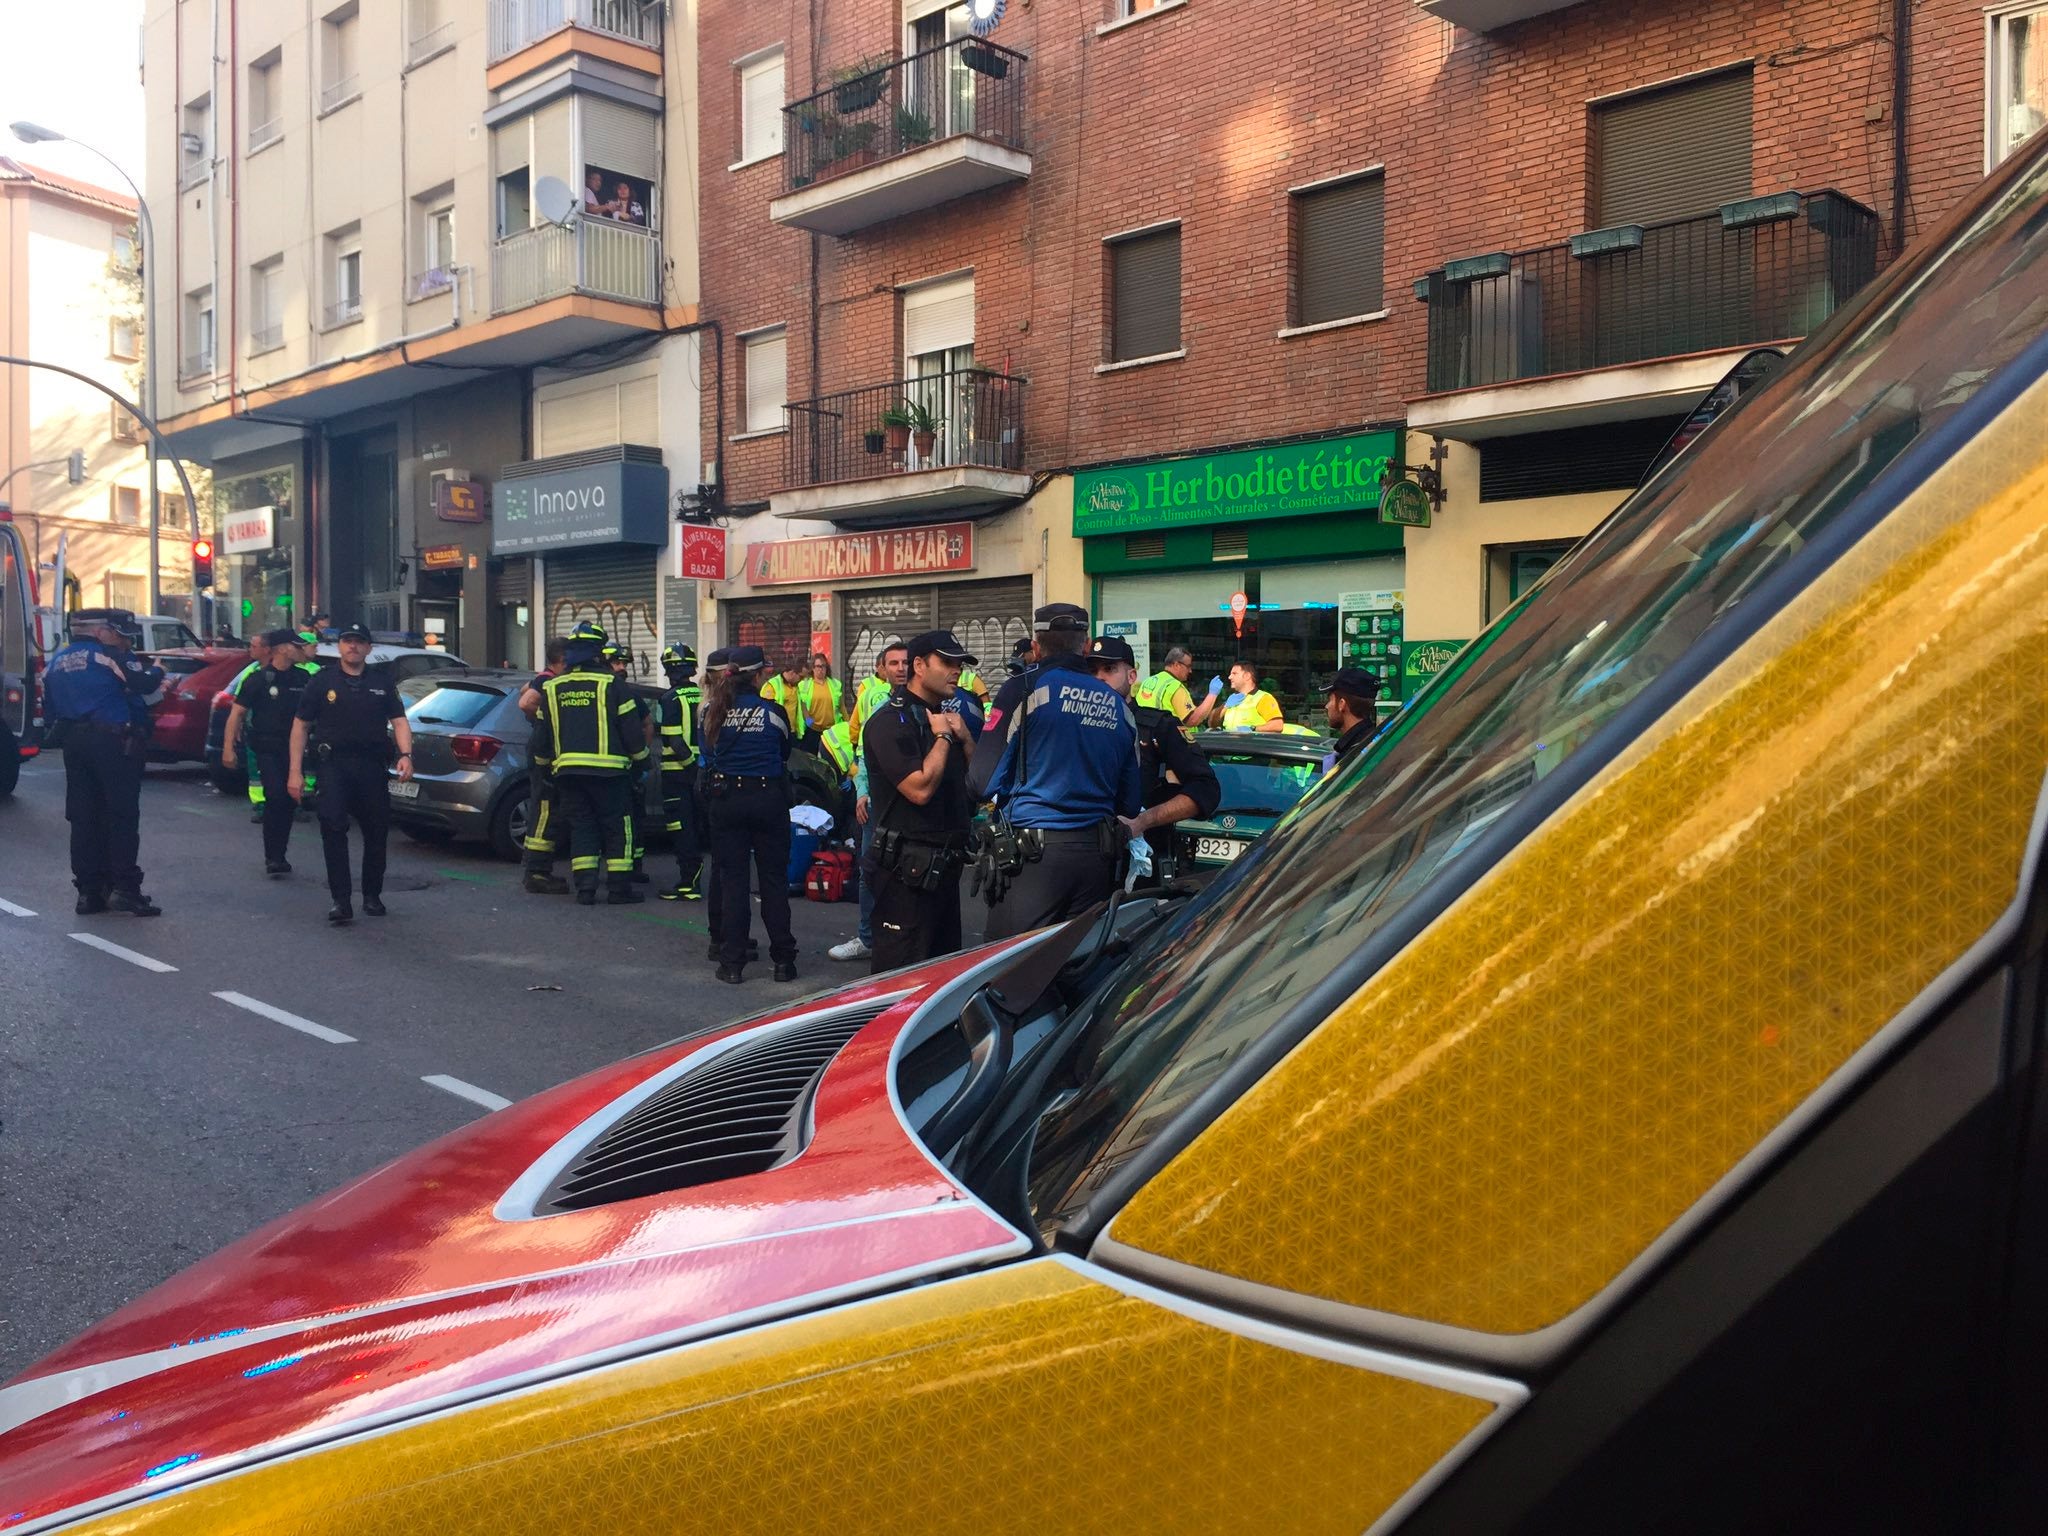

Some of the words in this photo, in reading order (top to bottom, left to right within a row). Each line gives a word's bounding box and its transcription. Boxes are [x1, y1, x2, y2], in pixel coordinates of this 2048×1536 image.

[1145, 445, 1389, 509] Herbodietética
[533, 486, 605, 515] Innova
[1076, 515, 1113, 530] Control
[1115, 515, 1127, 526] de
[1129, 513, 1152, 525] Peso
[1160, 508, 1212, 521] Alimentos
[1279, 492, 1340, 509] Cosmética
[1343, 489, 1382, 504] Natur
[701, 547, 708, 561] Y
[877, 535, 889, 571] Y
[893, 529, 948, 570] BAZAR
[690, 563, 717, 576] BAZAR
[1059, 685, 1116, 708] POLICÍA
[727, 706, 765, 718] OLICÍA
[1061, 699, 1118, 721] MUNICIPAL
[1080, 716, 1118, 730] Madrid
